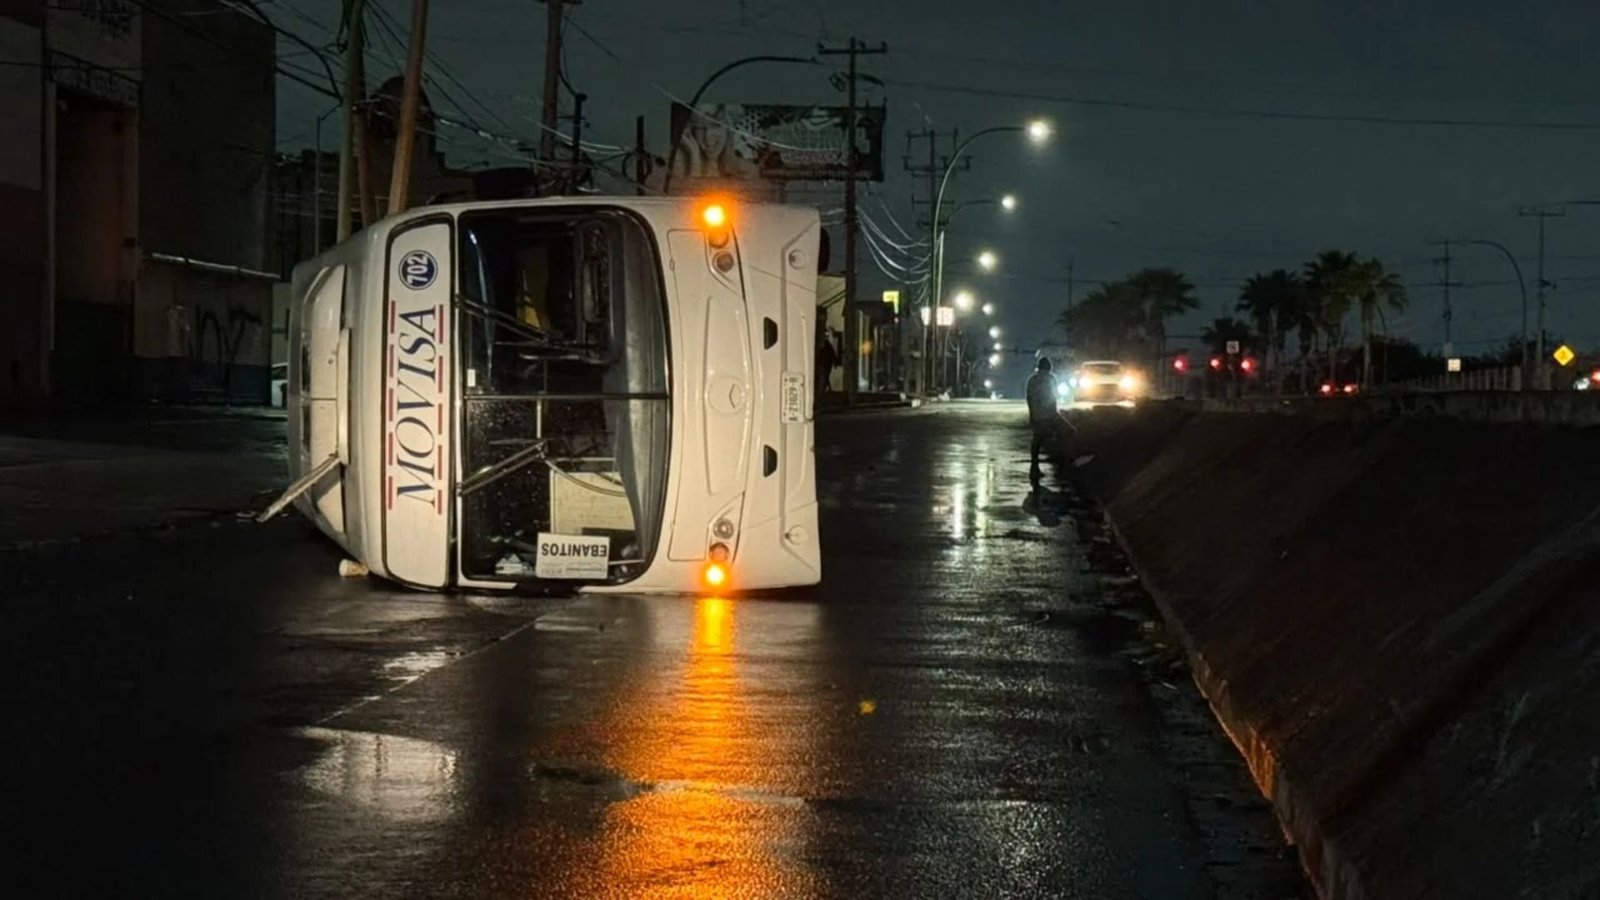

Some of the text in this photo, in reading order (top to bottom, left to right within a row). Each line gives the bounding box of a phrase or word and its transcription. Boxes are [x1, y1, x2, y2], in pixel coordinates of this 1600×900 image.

[406, 255, 428, 284] 702
[395, 304, 437, 508] MOVISA
[541, 543, 607, 557] EBANITOS
